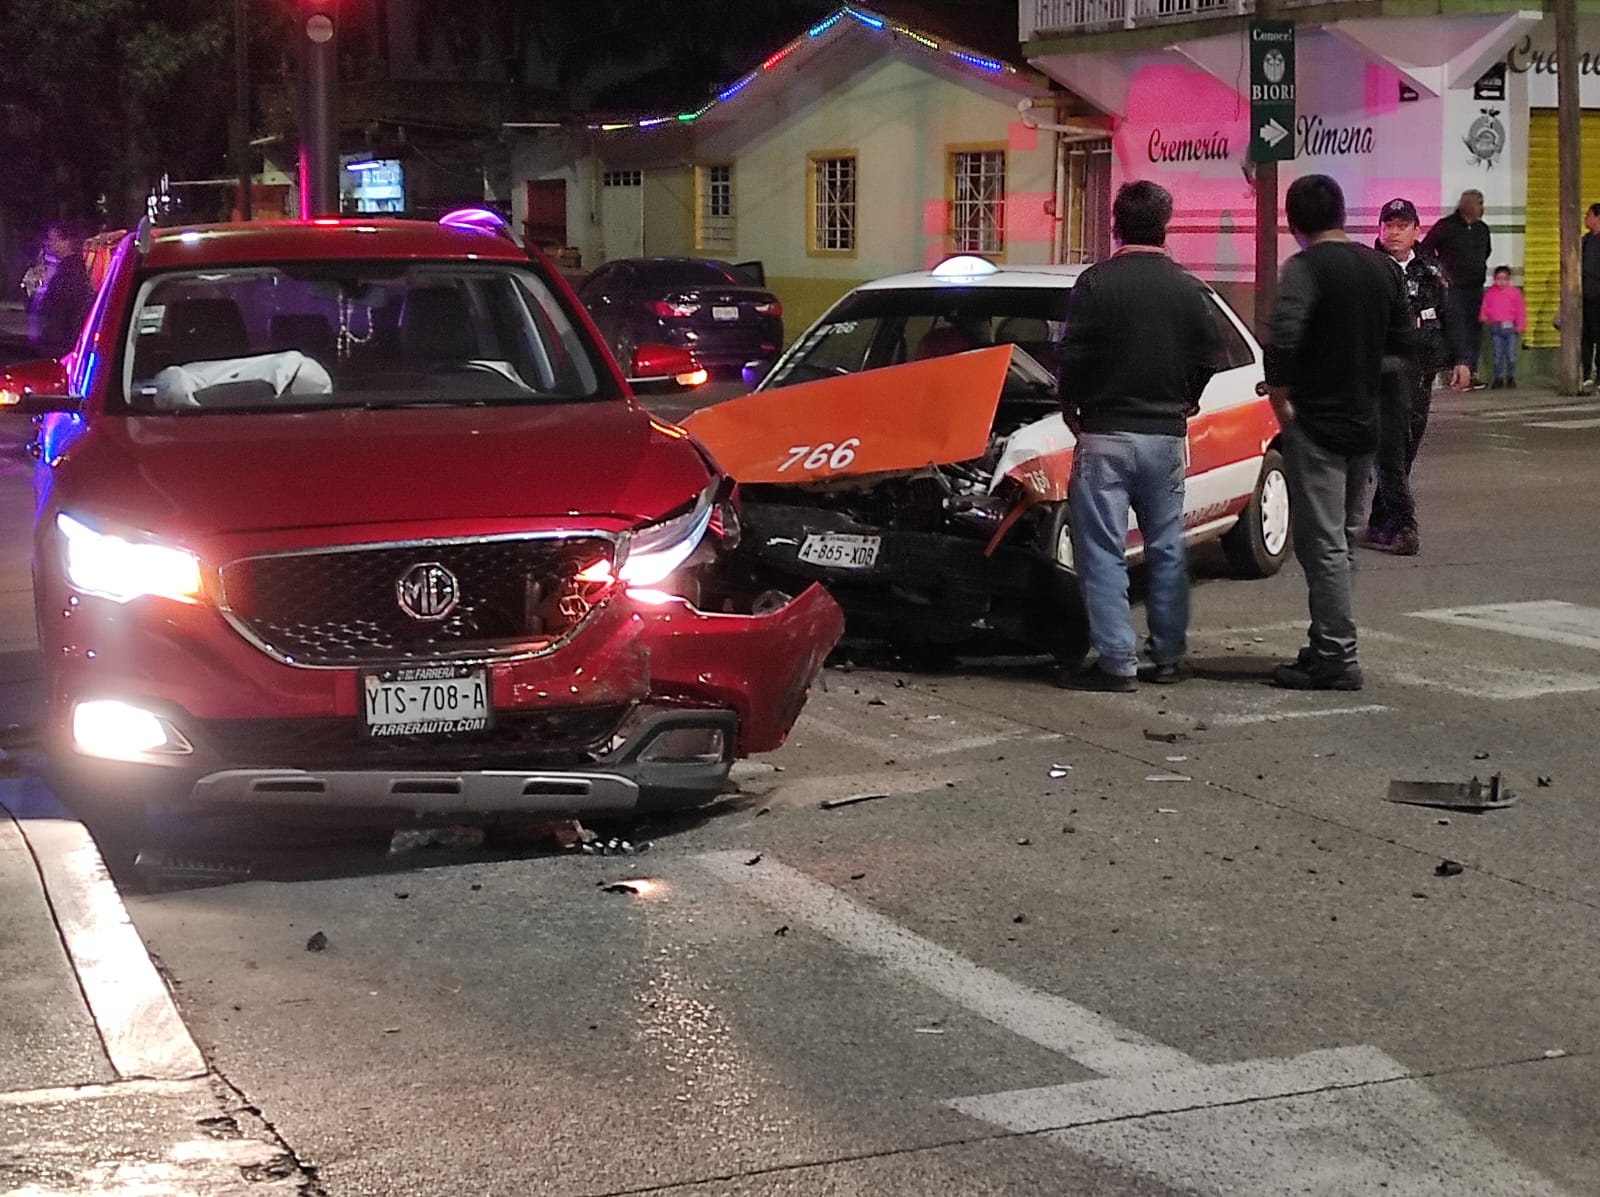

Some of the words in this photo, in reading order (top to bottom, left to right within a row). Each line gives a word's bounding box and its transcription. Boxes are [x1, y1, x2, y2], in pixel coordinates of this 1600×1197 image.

[1507, 34, 1600, 76] Cre
[1148, 128, 1230, 163] Cremería
[1296, 115, 1375, 158] Ximena
[777, 437, 861, 472] 766
[404, 568, 453, 615] MG
[367, 683, 485, 716] YTS-708-A
[371, 718, 486, 737] FARRERAUTO.COM
